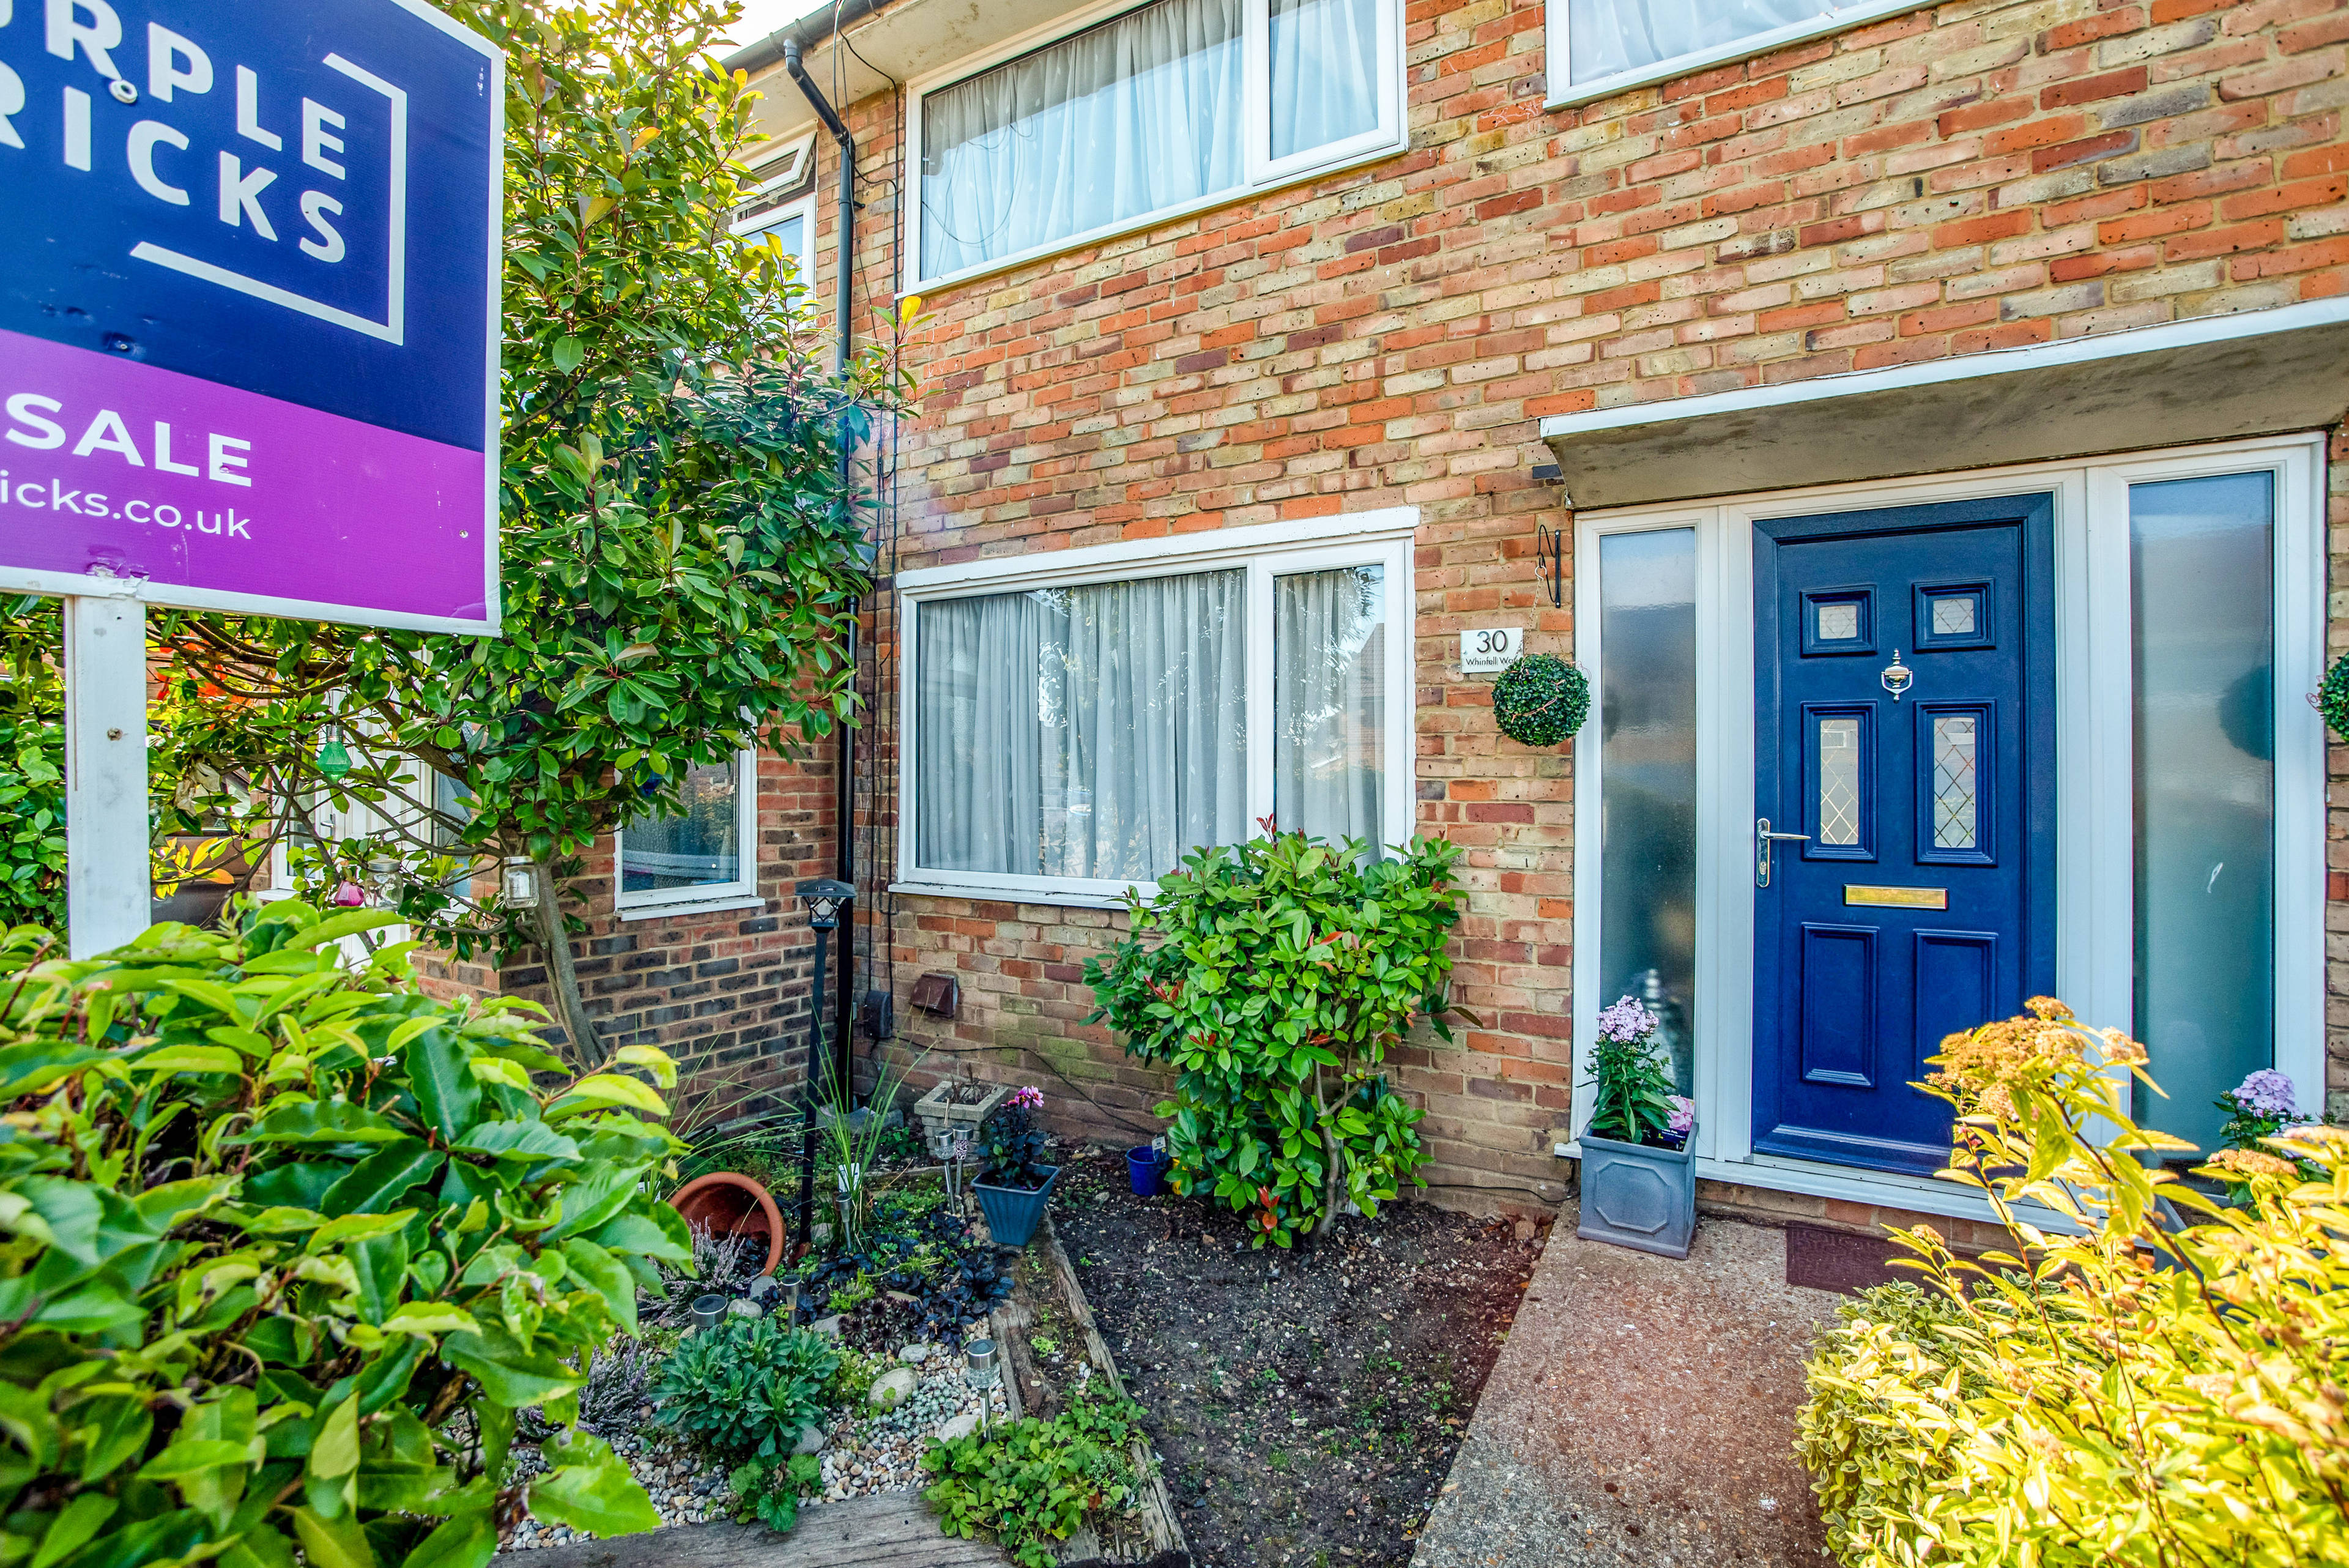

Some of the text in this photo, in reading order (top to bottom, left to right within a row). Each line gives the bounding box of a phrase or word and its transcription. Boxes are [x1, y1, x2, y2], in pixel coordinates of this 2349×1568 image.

[0, 0, 346, 180] RPLE
[5, 393, 252, 488] SALE
[0, 469, 252, 540] icks.co.uk
[1466, 656, 1497, 666] Whinfell
[1477, 630, 1508, 653] 30
